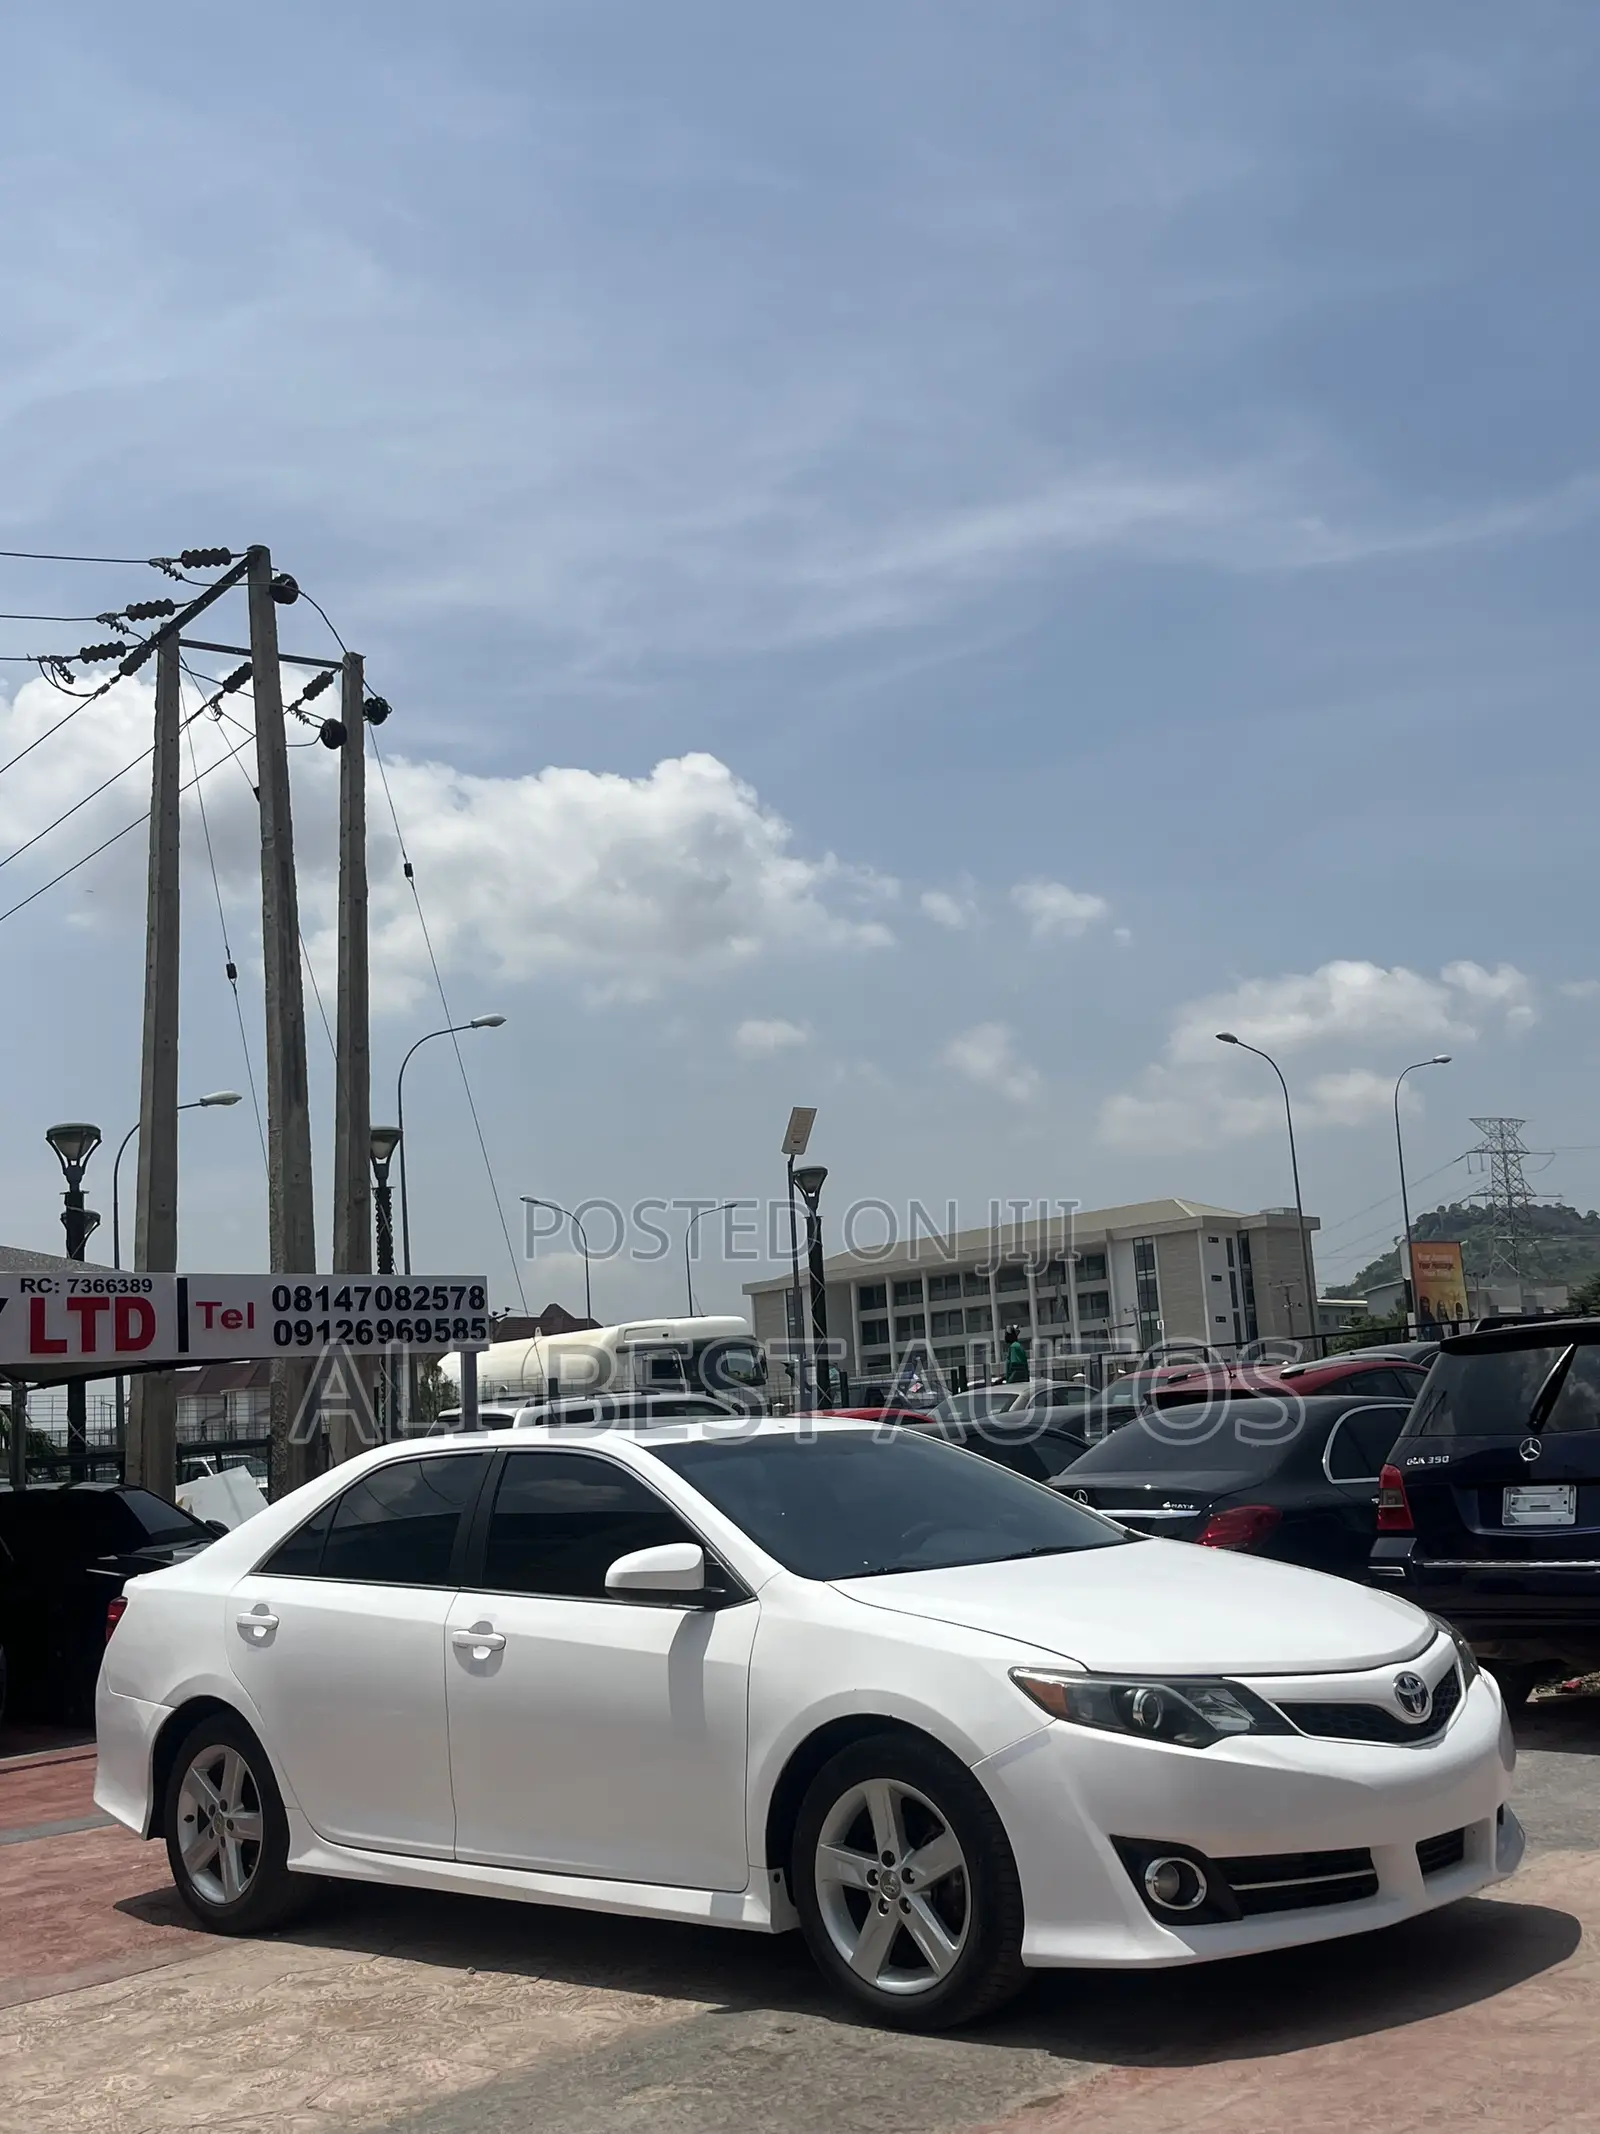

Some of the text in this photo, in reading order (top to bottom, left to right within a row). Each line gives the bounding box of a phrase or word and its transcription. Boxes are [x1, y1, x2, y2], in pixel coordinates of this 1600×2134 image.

[20, 1277, 153, 1294] RC: 7366389
[272, 1285, 485, 1312] 08147082578
[30, 1296, 156, 1354] LTD
[196, 1301, 255, 1330] Tel
[273, 1317, 487, 1346] 09126969585
